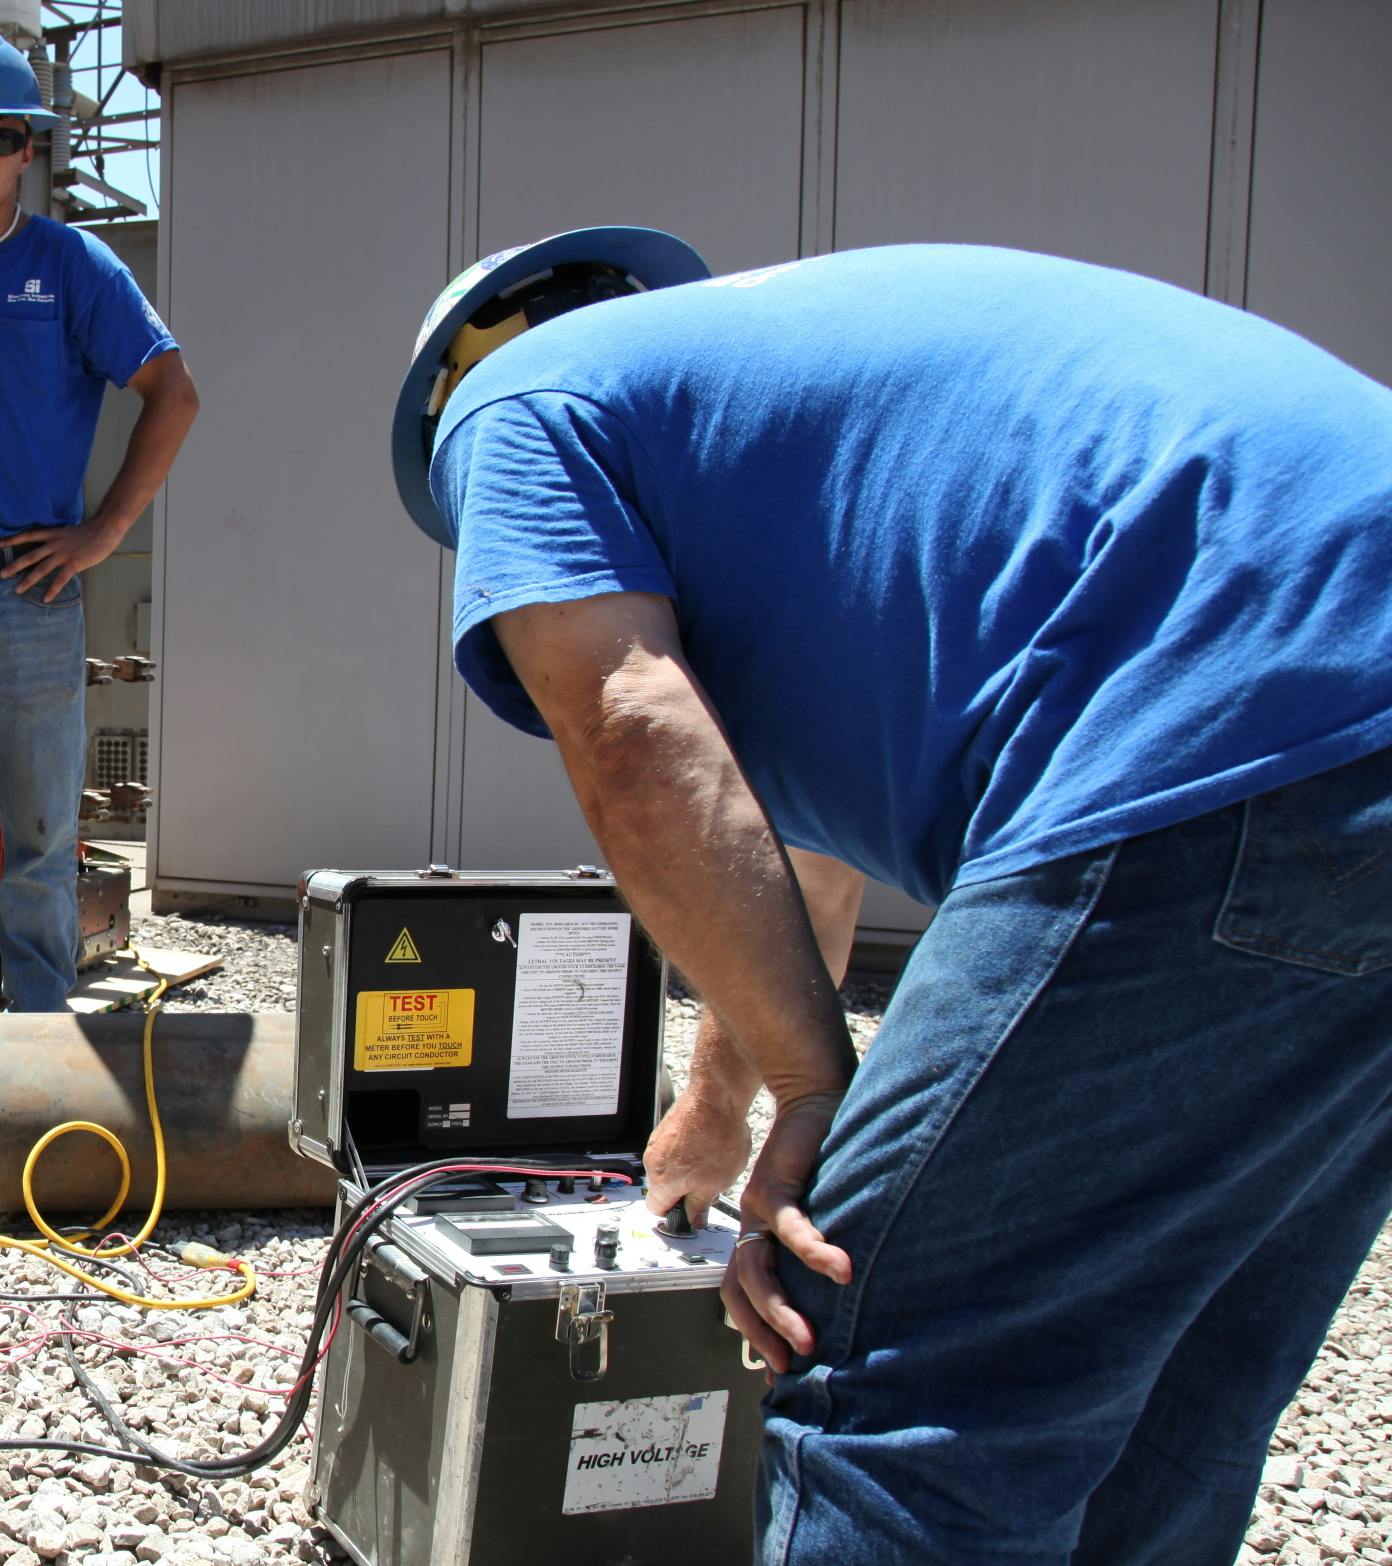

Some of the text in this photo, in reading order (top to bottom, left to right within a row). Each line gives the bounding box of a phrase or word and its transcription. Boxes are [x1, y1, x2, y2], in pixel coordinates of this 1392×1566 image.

[389, 994, 438, 1012] TEST
[388, 1014, 415, 1022] BEFORE
[376, 1034, 406, 1042] ALWAYS
[407, 1033, 424, 1042] TEST
[426, 1033, 444, 1041] WITH
[391, 1043, 420, 1051] BEFORE
[422, 1042, 437, 1050] YOU
[439, 1041, 463, 1050] TOUCH
[368, 1050, 459, 1061] ANY CIRCUIT CONDUCTOR
[576, 1442, 710, 1470] HIGH VOLTGE
